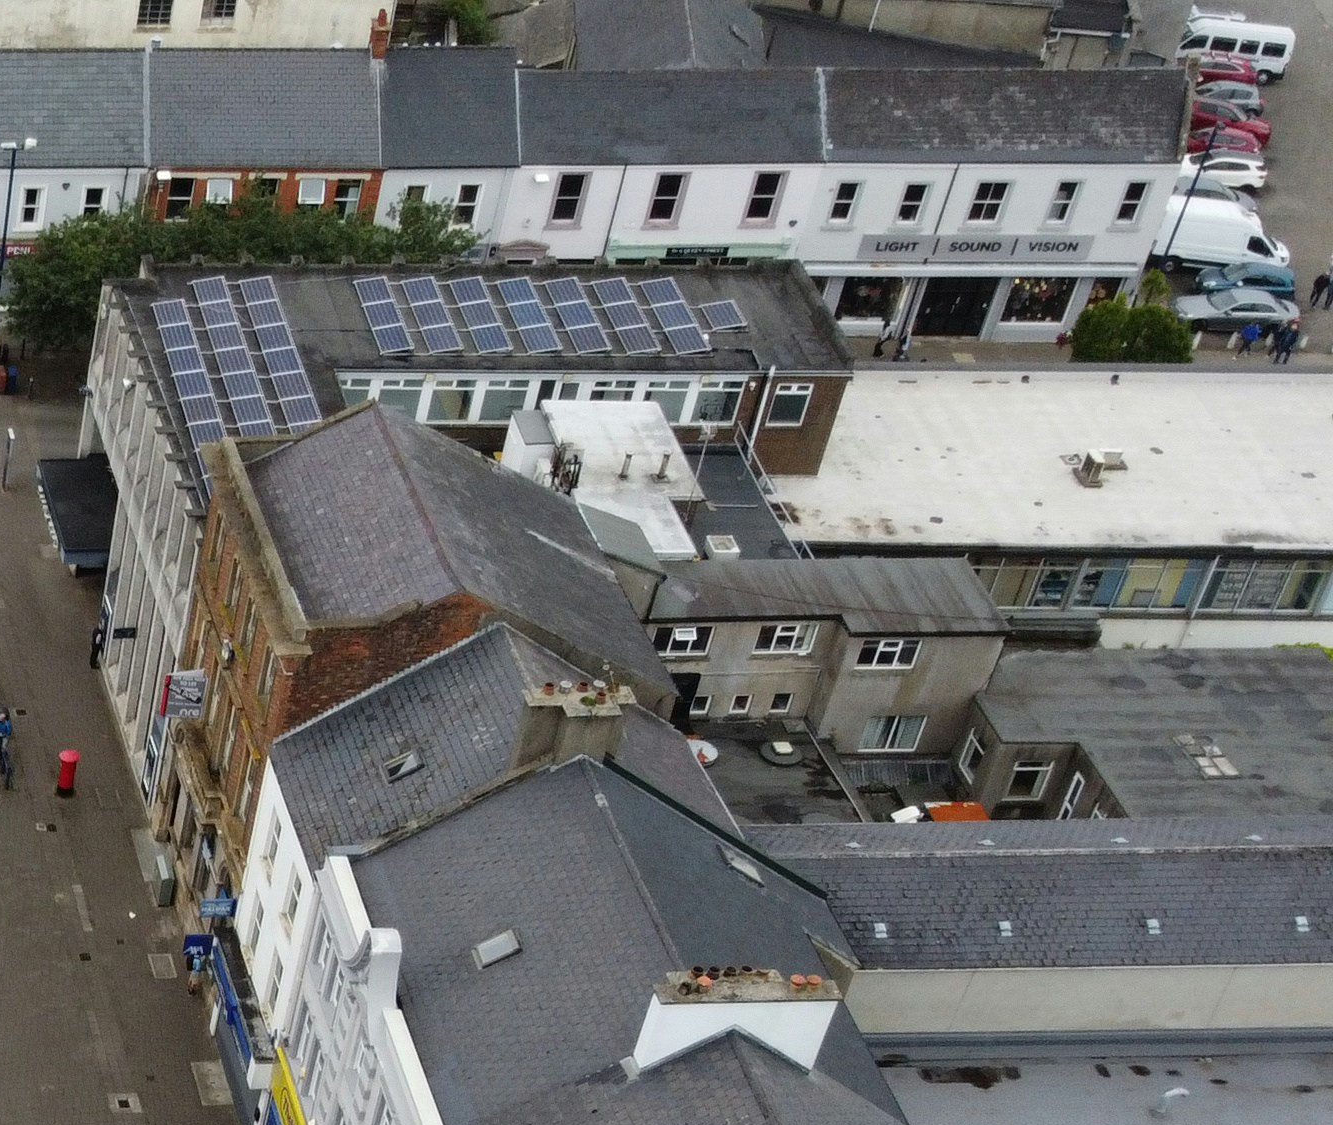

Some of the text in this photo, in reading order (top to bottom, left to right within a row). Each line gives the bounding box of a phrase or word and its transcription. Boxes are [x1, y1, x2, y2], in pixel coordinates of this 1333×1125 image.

[875, 241, 1079, 252] LIGHT SOUND VISION
